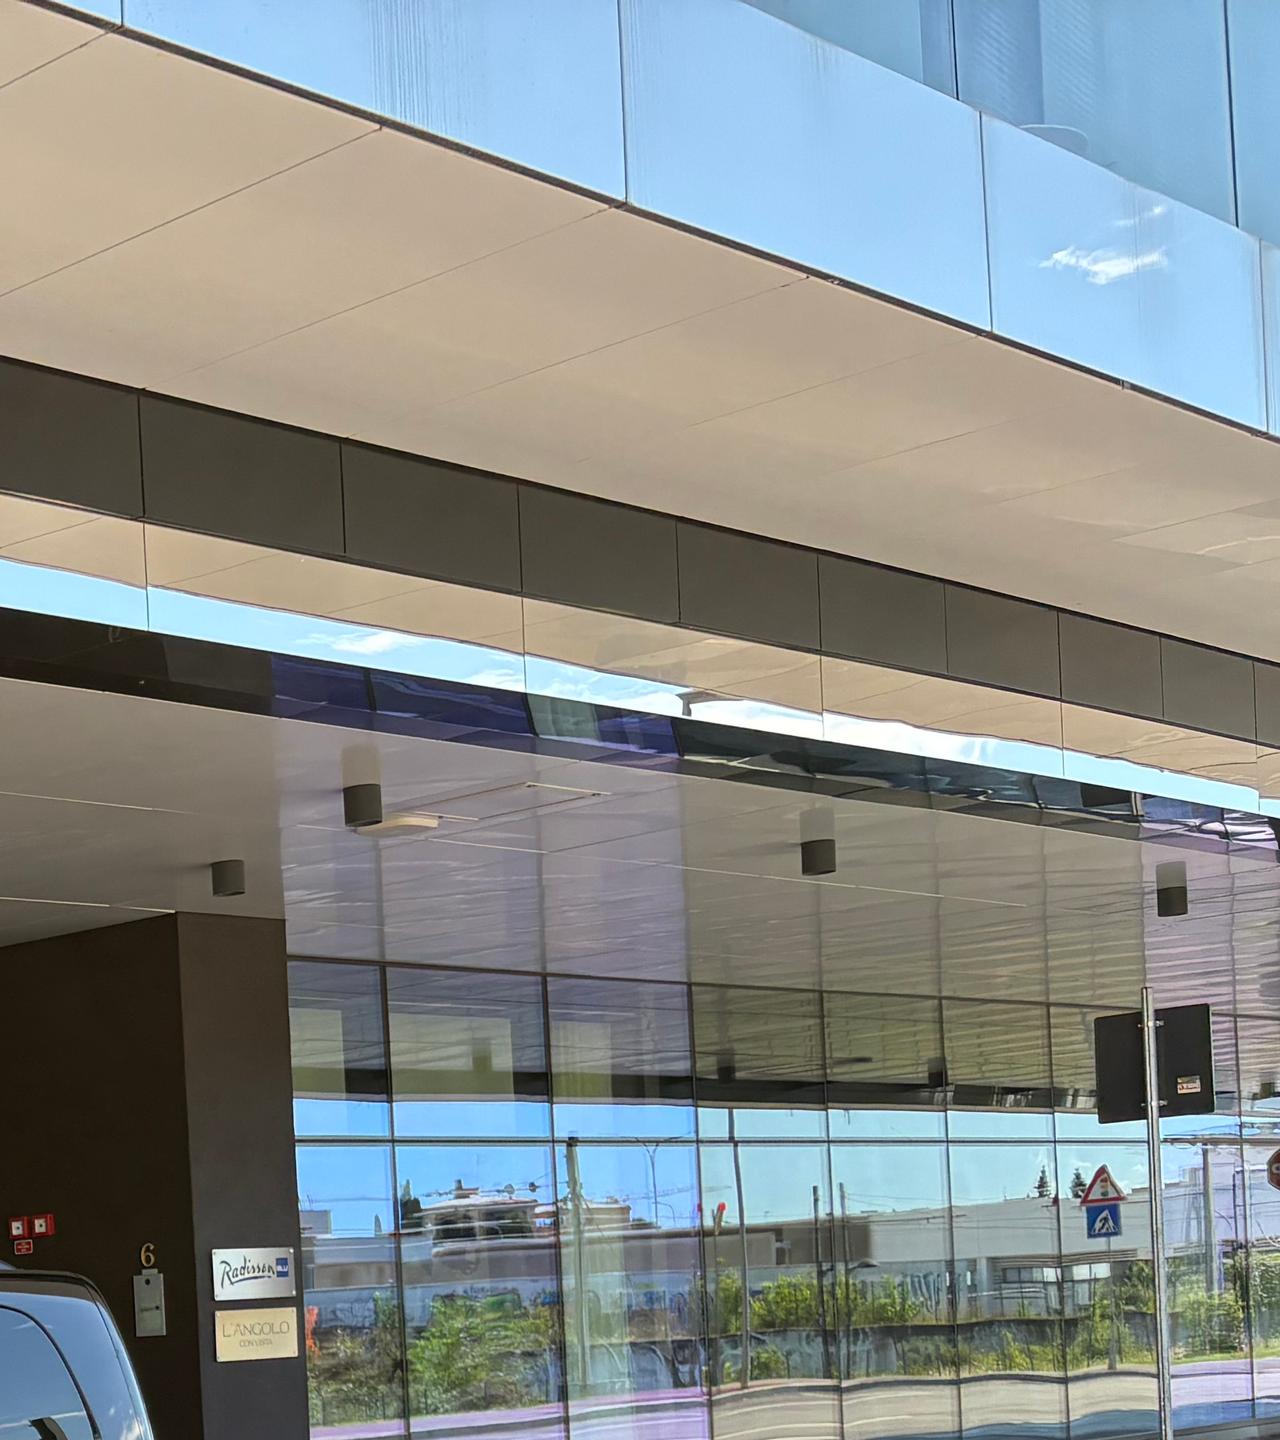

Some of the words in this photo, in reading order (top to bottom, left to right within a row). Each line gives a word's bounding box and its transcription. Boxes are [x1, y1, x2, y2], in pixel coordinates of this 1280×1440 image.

[141, 1243, 155, 1267] 6
[219, 1255, 275, 1288] Radisson
[222, 1321, 290, 1338] L'ANGOLO
